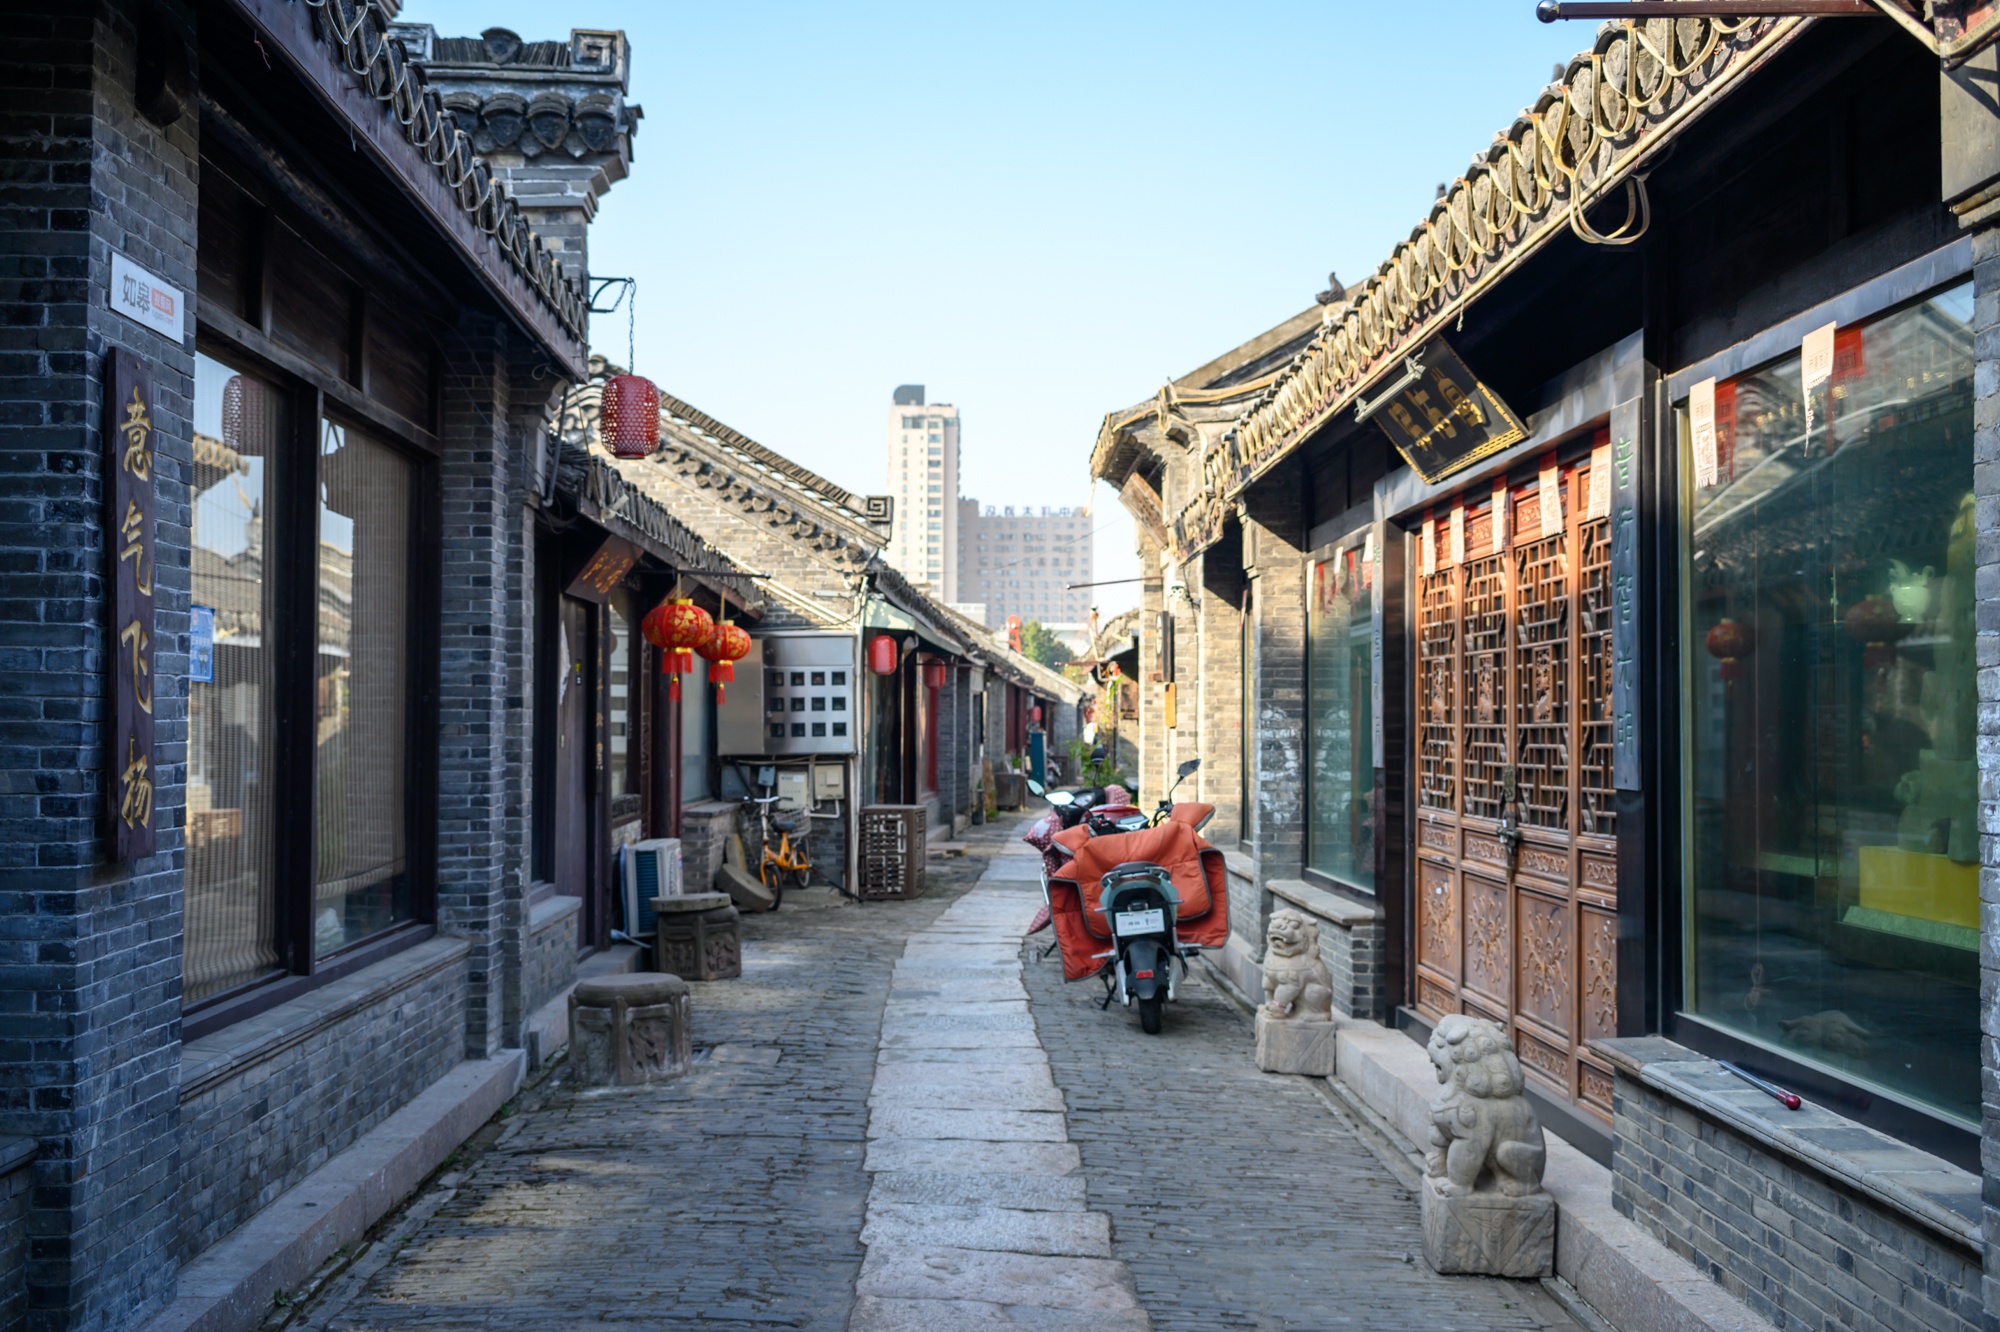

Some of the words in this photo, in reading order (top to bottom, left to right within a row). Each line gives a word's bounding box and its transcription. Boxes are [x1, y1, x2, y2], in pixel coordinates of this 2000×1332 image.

[123, 273, 150, 314] 如皋
[120, 386, 153, 831] 意气飞扬
